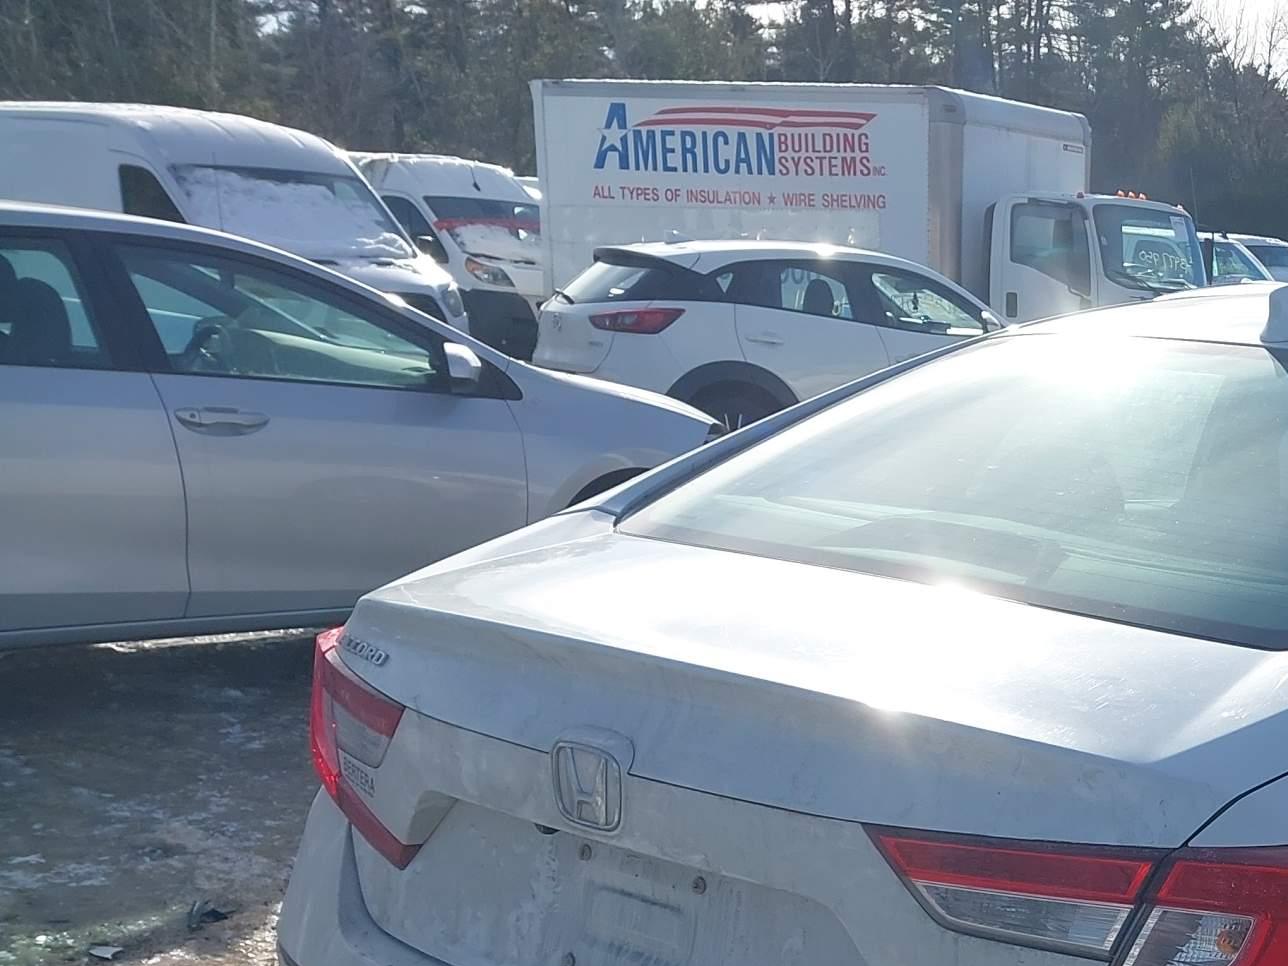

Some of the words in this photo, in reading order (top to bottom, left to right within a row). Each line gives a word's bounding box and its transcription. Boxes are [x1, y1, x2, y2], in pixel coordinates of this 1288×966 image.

[593, 102, 776, 176] AMERICAN
[777, 132, 869, 153] BUILDING
[778, 155, 872, 176] SYSTEMS
[592, 185, 616, 200] ALL
[618, 186, 660, 202] TYPES
[664, 188, 681, 202] OF
[686, 189, 761, 206] INSULATION
[782, 192, 816, 208] WIRE
[821, 193, 887, 209] SHELVING
